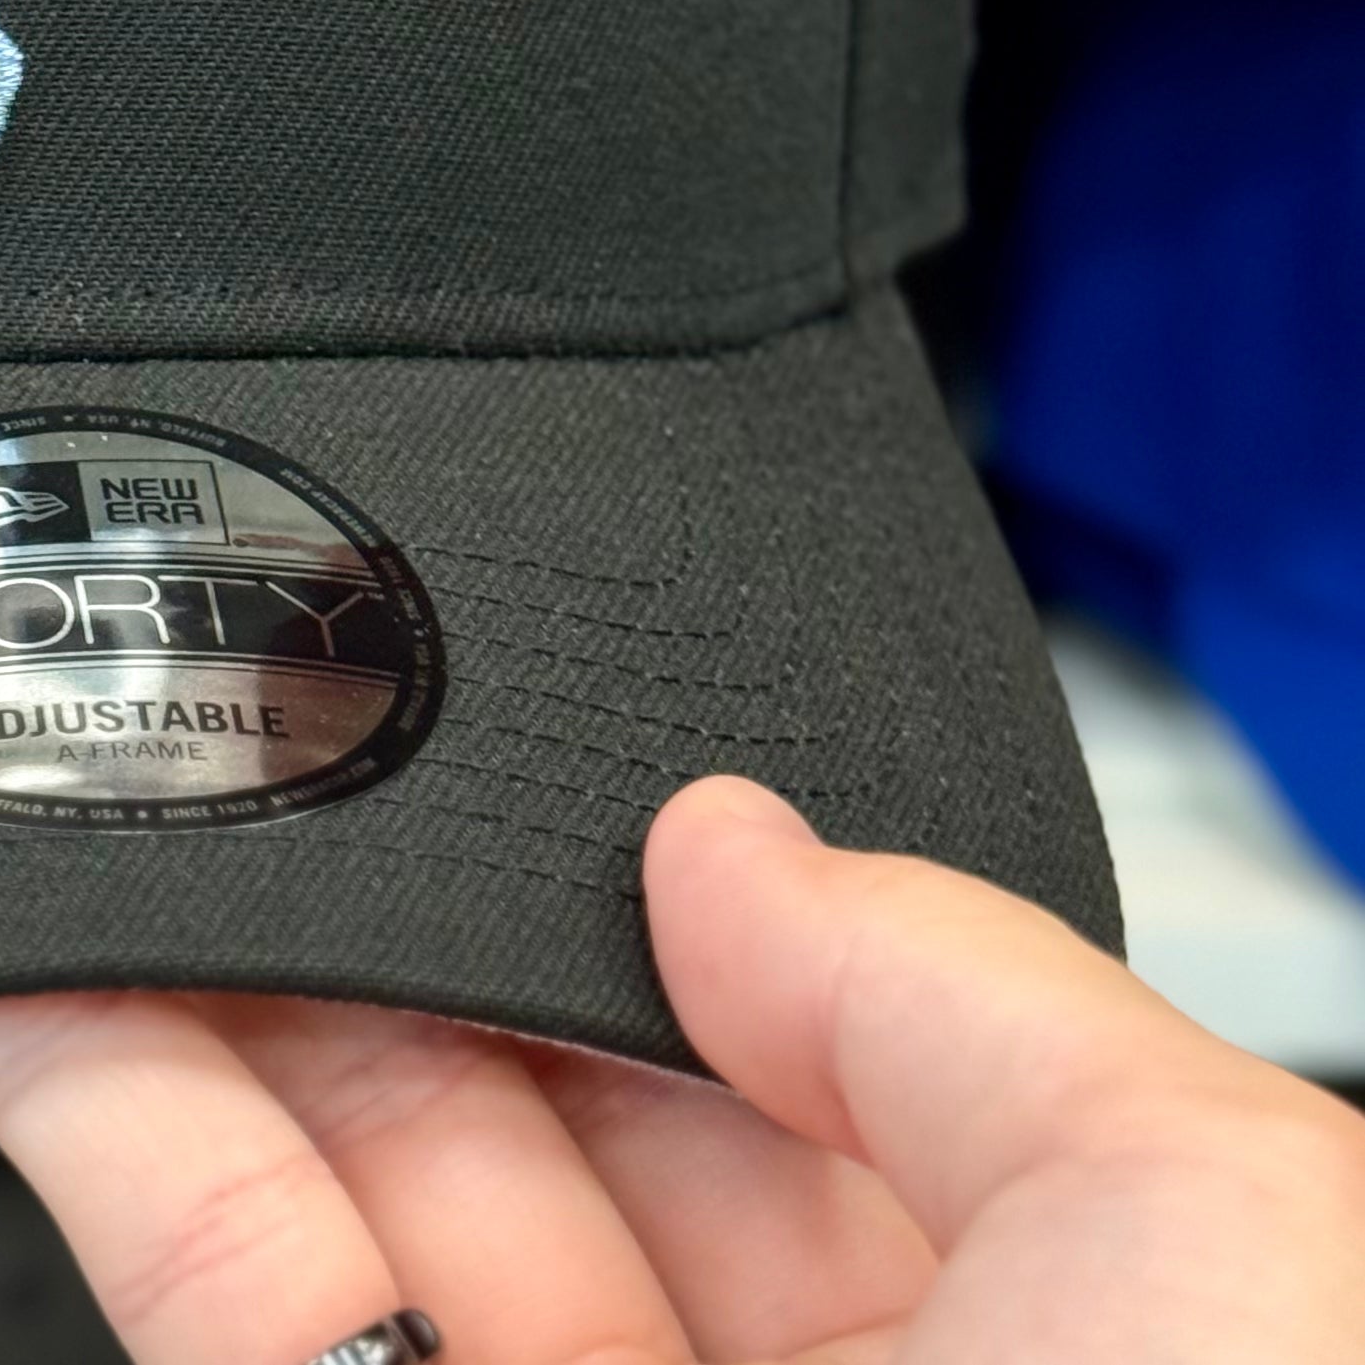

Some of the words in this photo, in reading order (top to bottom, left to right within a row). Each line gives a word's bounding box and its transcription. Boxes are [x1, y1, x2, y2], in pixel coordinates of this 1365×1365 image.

[100, 477, 199, 501] NEW
[105, 502, 205, 525] ERA
[57, 740, 209, 763] A-FRAME
[89, 807, 124, 820] USA
[161, 805, 213, 820] SINCE
[217, 799, 258, 816] 1920
